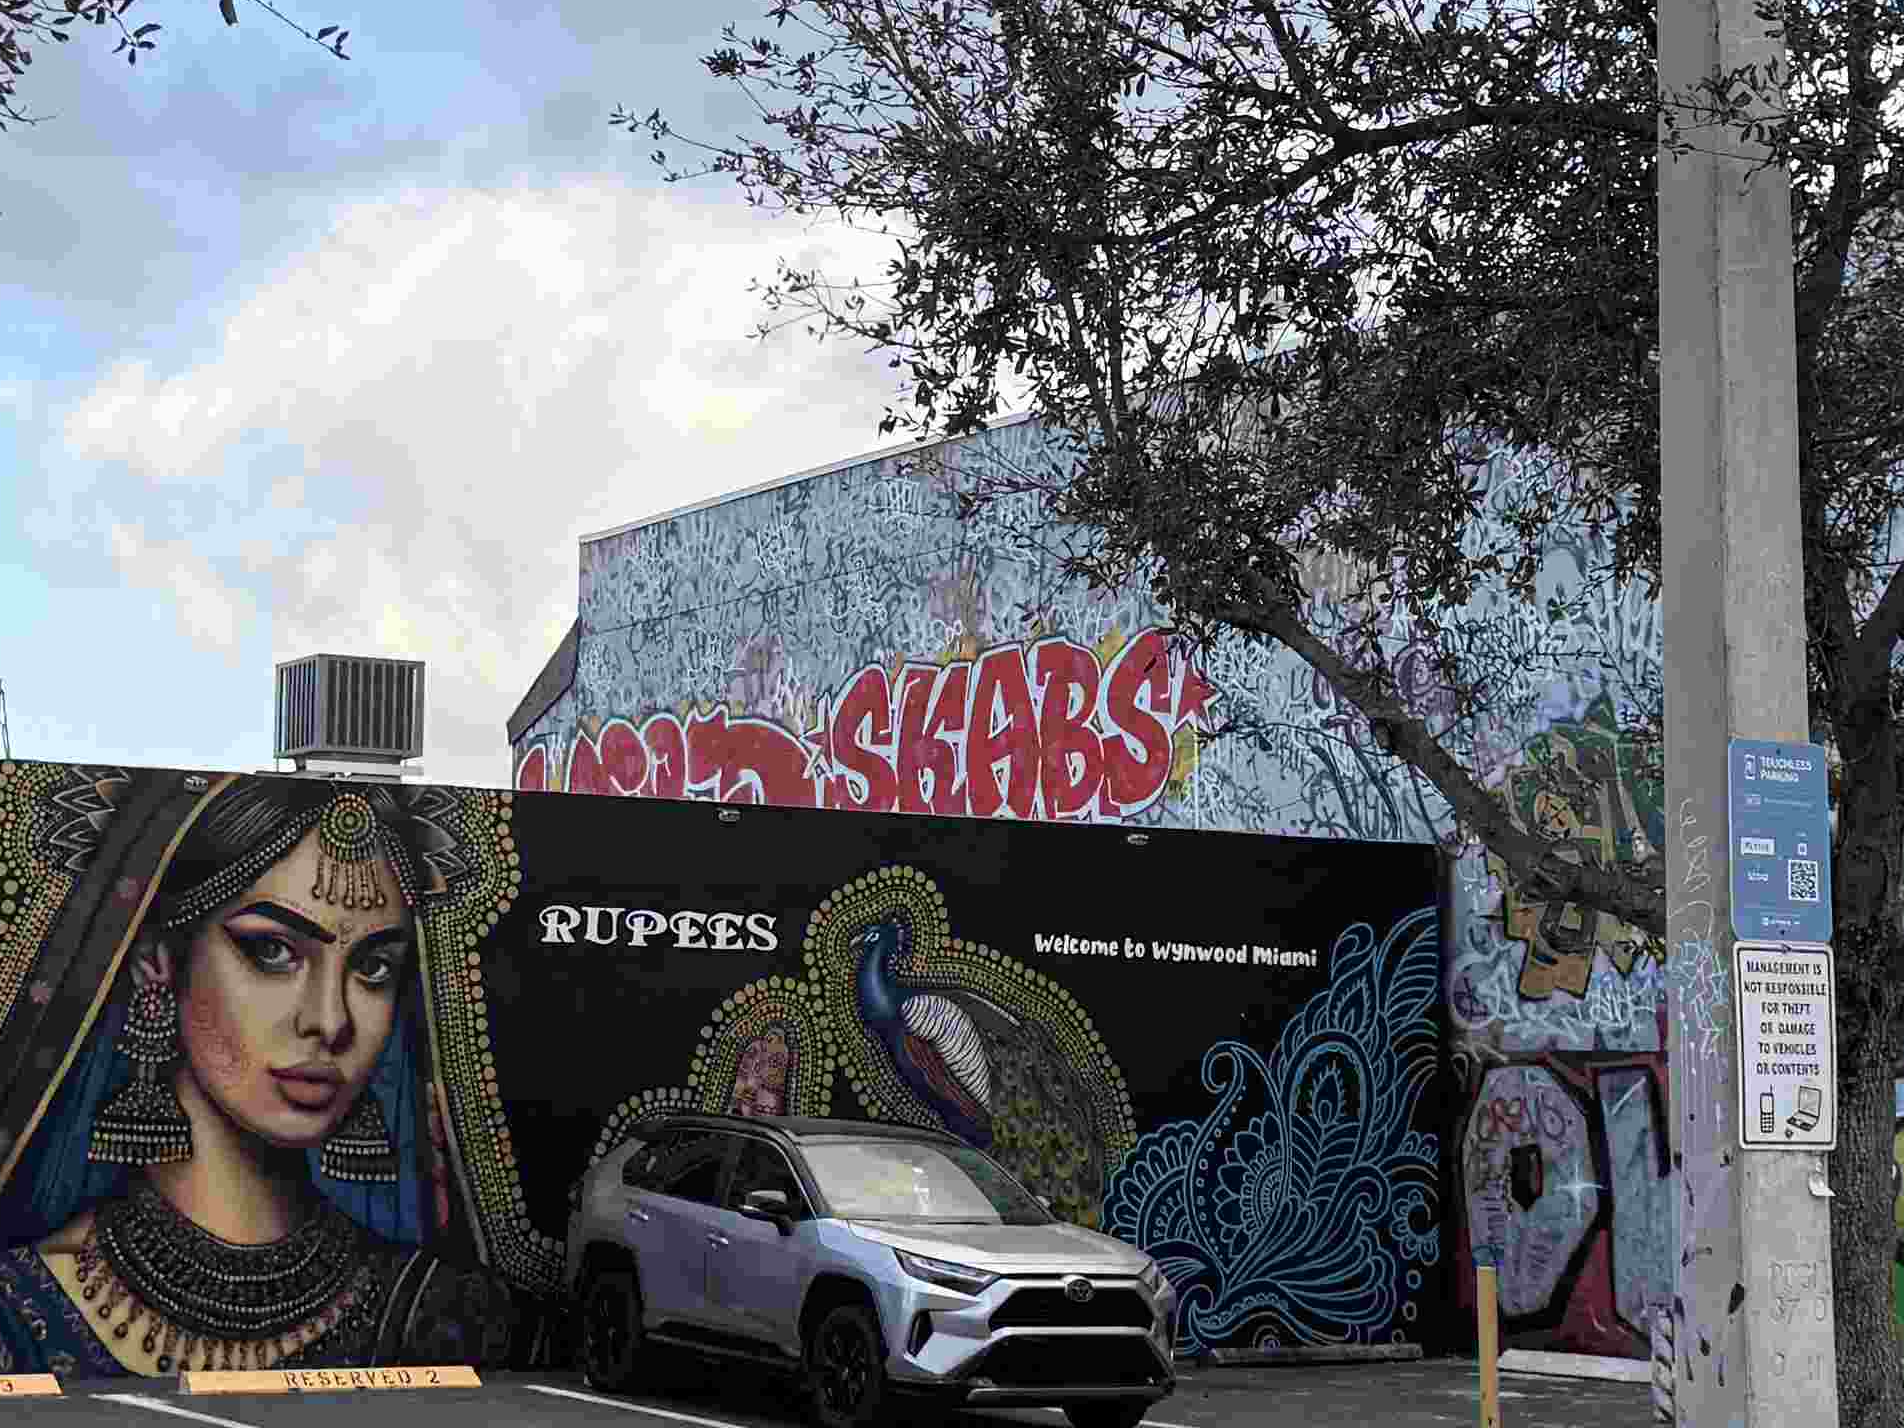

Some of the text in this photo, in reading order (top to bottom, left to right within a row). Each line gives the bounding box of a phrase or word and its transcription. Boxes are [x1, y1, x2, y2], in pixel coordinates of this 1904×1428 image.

[538, 904, 779, 952] RUPEES
[1033, 933, 1317, 967] Welcome to Wynwood Miami
[1746, 960, 1823, 975] MANAGEMENT IS
[1743, 981, 1827, 996] NOT RESPONSIBLE
[1761, 1002, 1811, 1015] FOR THEFT
[1760, 1021, 1816, 1036] OR DAMAGE
[1757, 1042, 1817, 1056] TO VEHICLES
[1756, 1062, 1820, 1077] OR CONTENTS
[0, 1378, 14, 1394] 3
[282, 1369, 441, 1390] RESERVED 2
